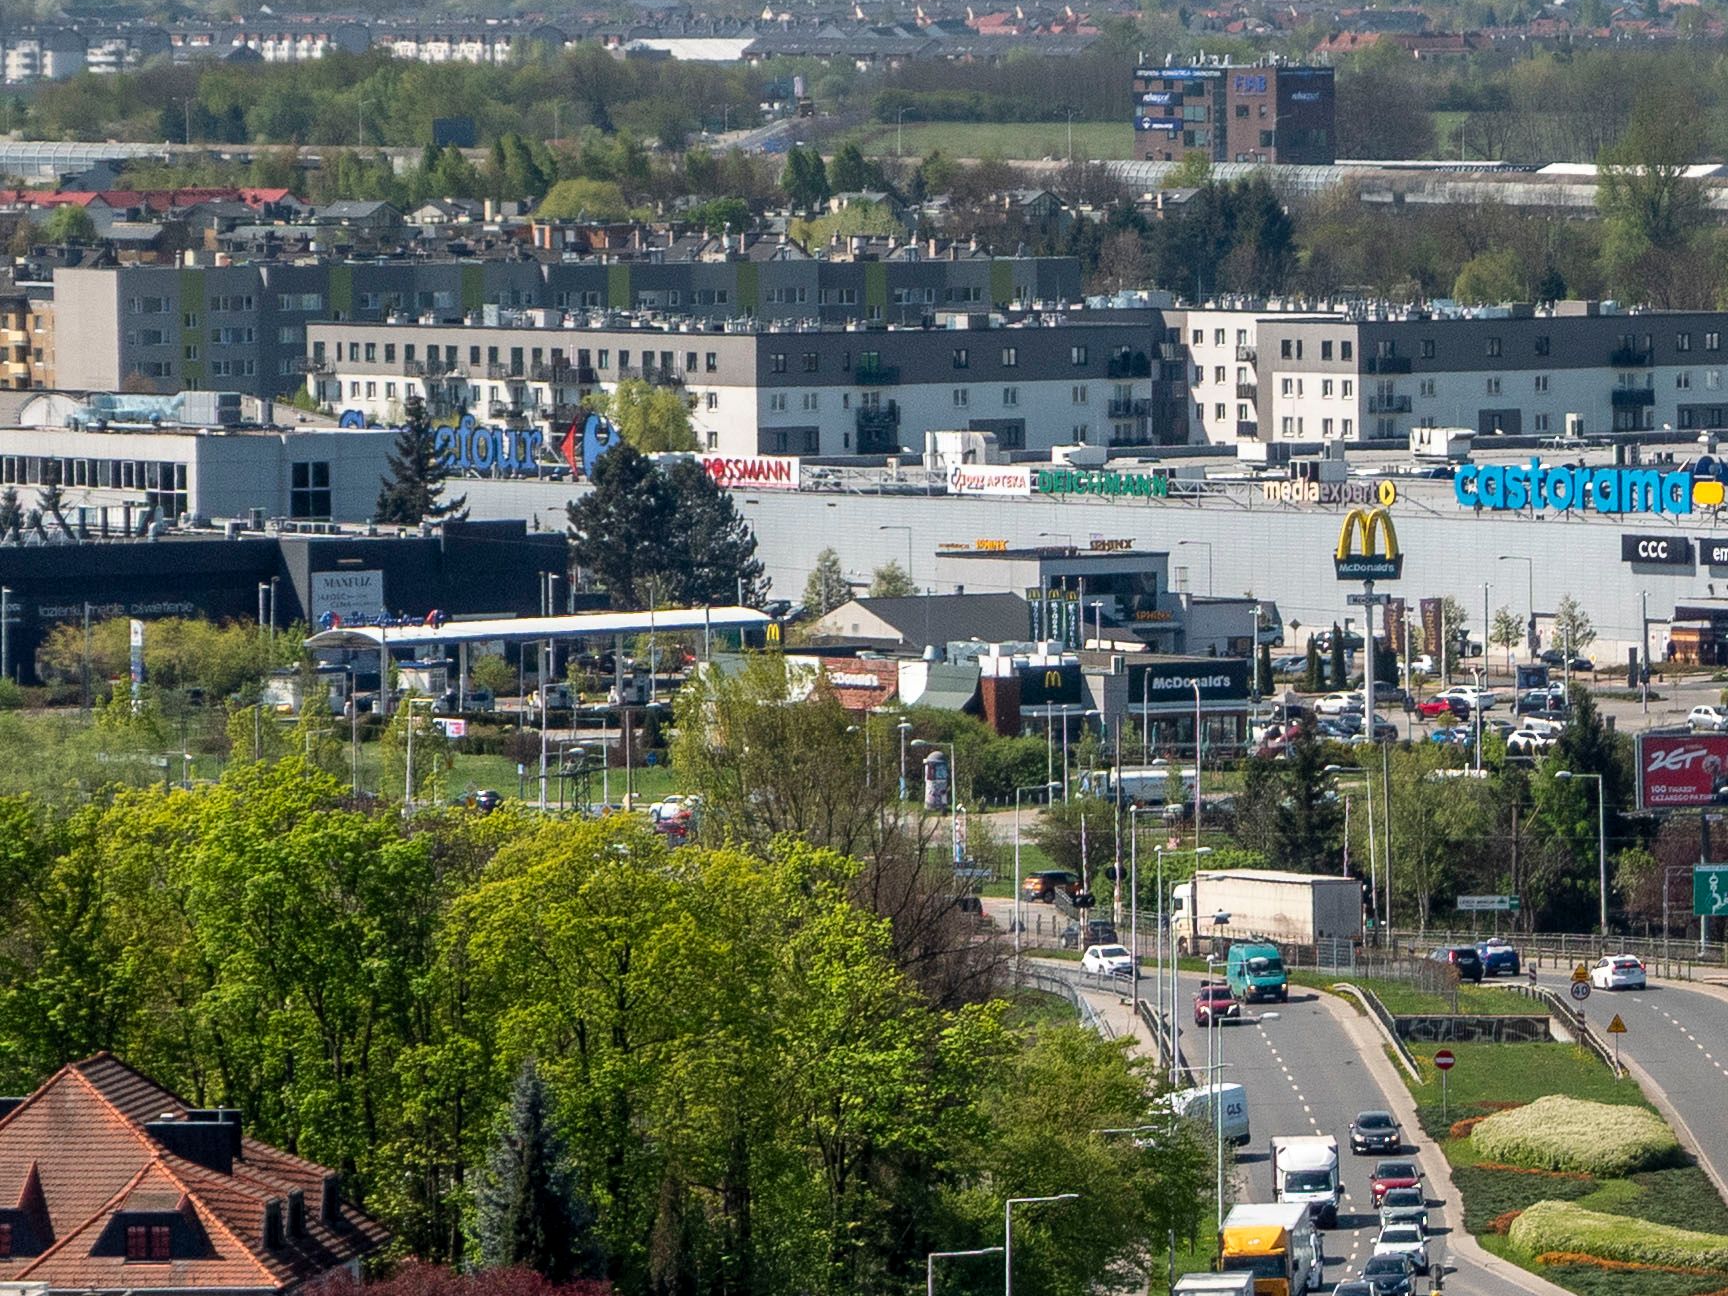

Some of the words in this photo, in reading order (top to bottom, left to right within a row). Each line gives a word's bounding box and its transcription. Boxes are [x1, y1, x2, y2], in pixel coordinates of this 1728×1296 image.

[703, 458, 791, 483] ROSSMANN
[986, 475, 1026, 489] APTEKA
[1038, 470, 1168, 497] DEICHMANN
[1263, 477, 1378, 505] mediaexpert
[1454, 456, 1693, 515] castorama
[1638, 540, 1668, 559] CCC
[1339, 563, 1395, 573] McDonald's
[1650, 784, 1667, 794] 100
[1573, 984, 1589, 997] 40
